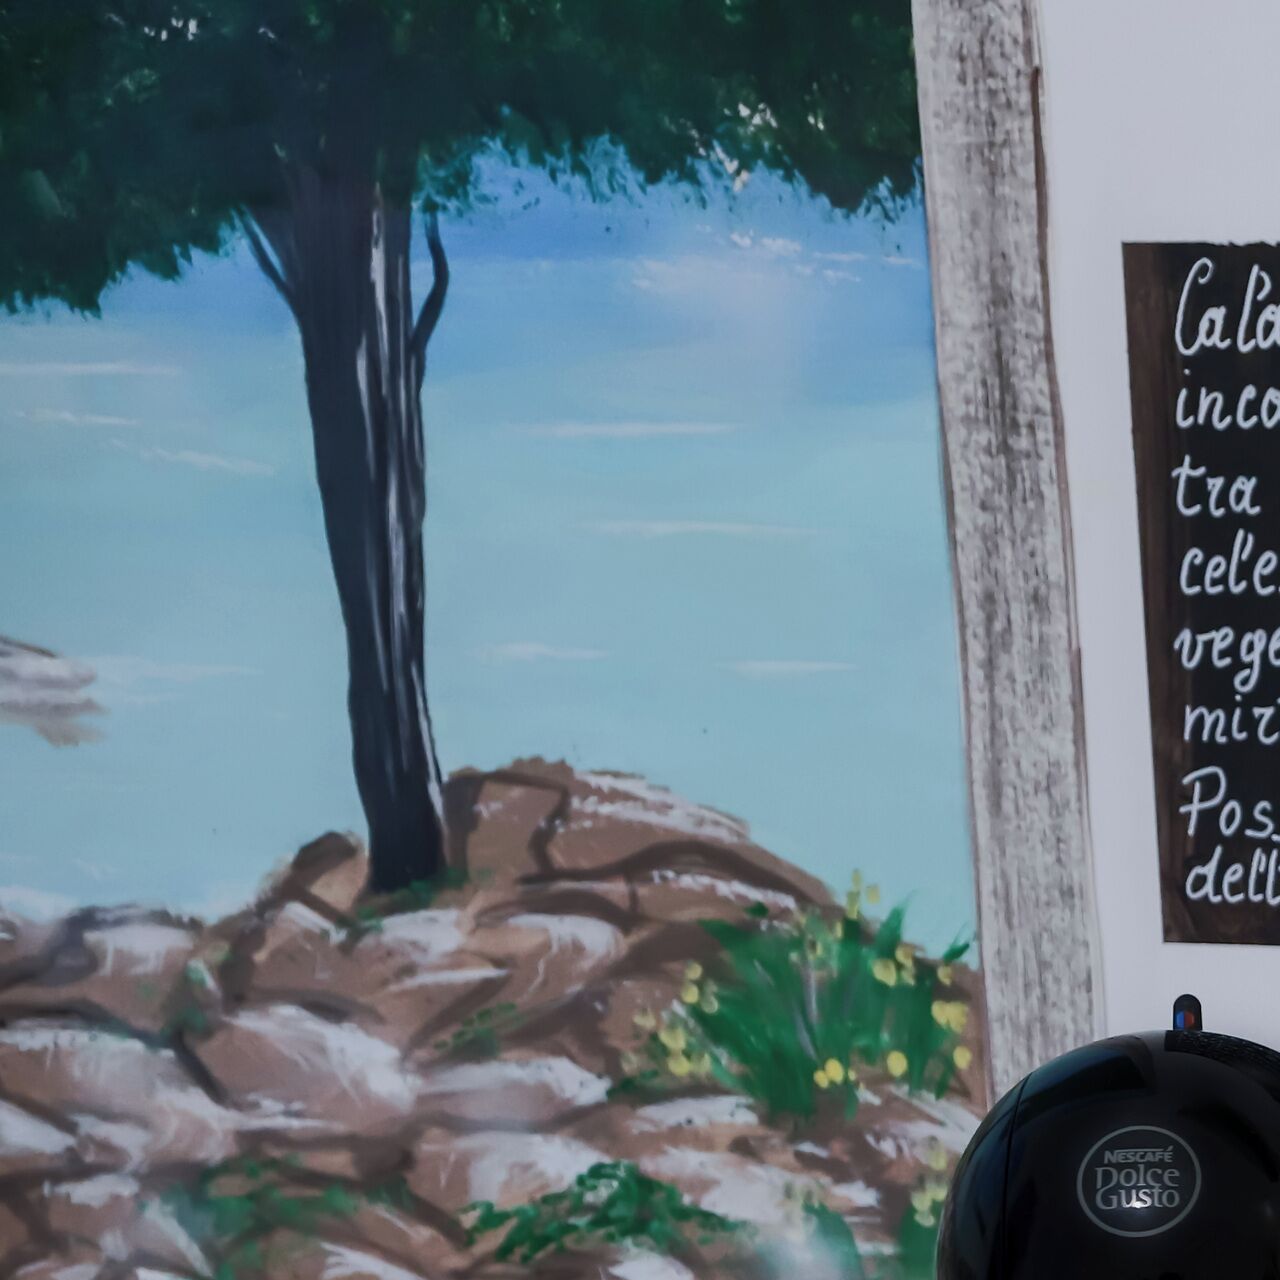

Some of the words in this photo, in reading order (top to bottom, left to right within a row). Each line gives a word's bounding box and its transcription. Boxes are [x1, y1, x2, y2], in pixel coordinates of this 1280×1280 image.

[1171, 453, 1261, 518] tra
[1104, 1145, 1174, 1164] NESCAFÉ
[1095, 1164, 1181, 1190] Dolce
[1096, 1186, 1181, 1210] Gusto
